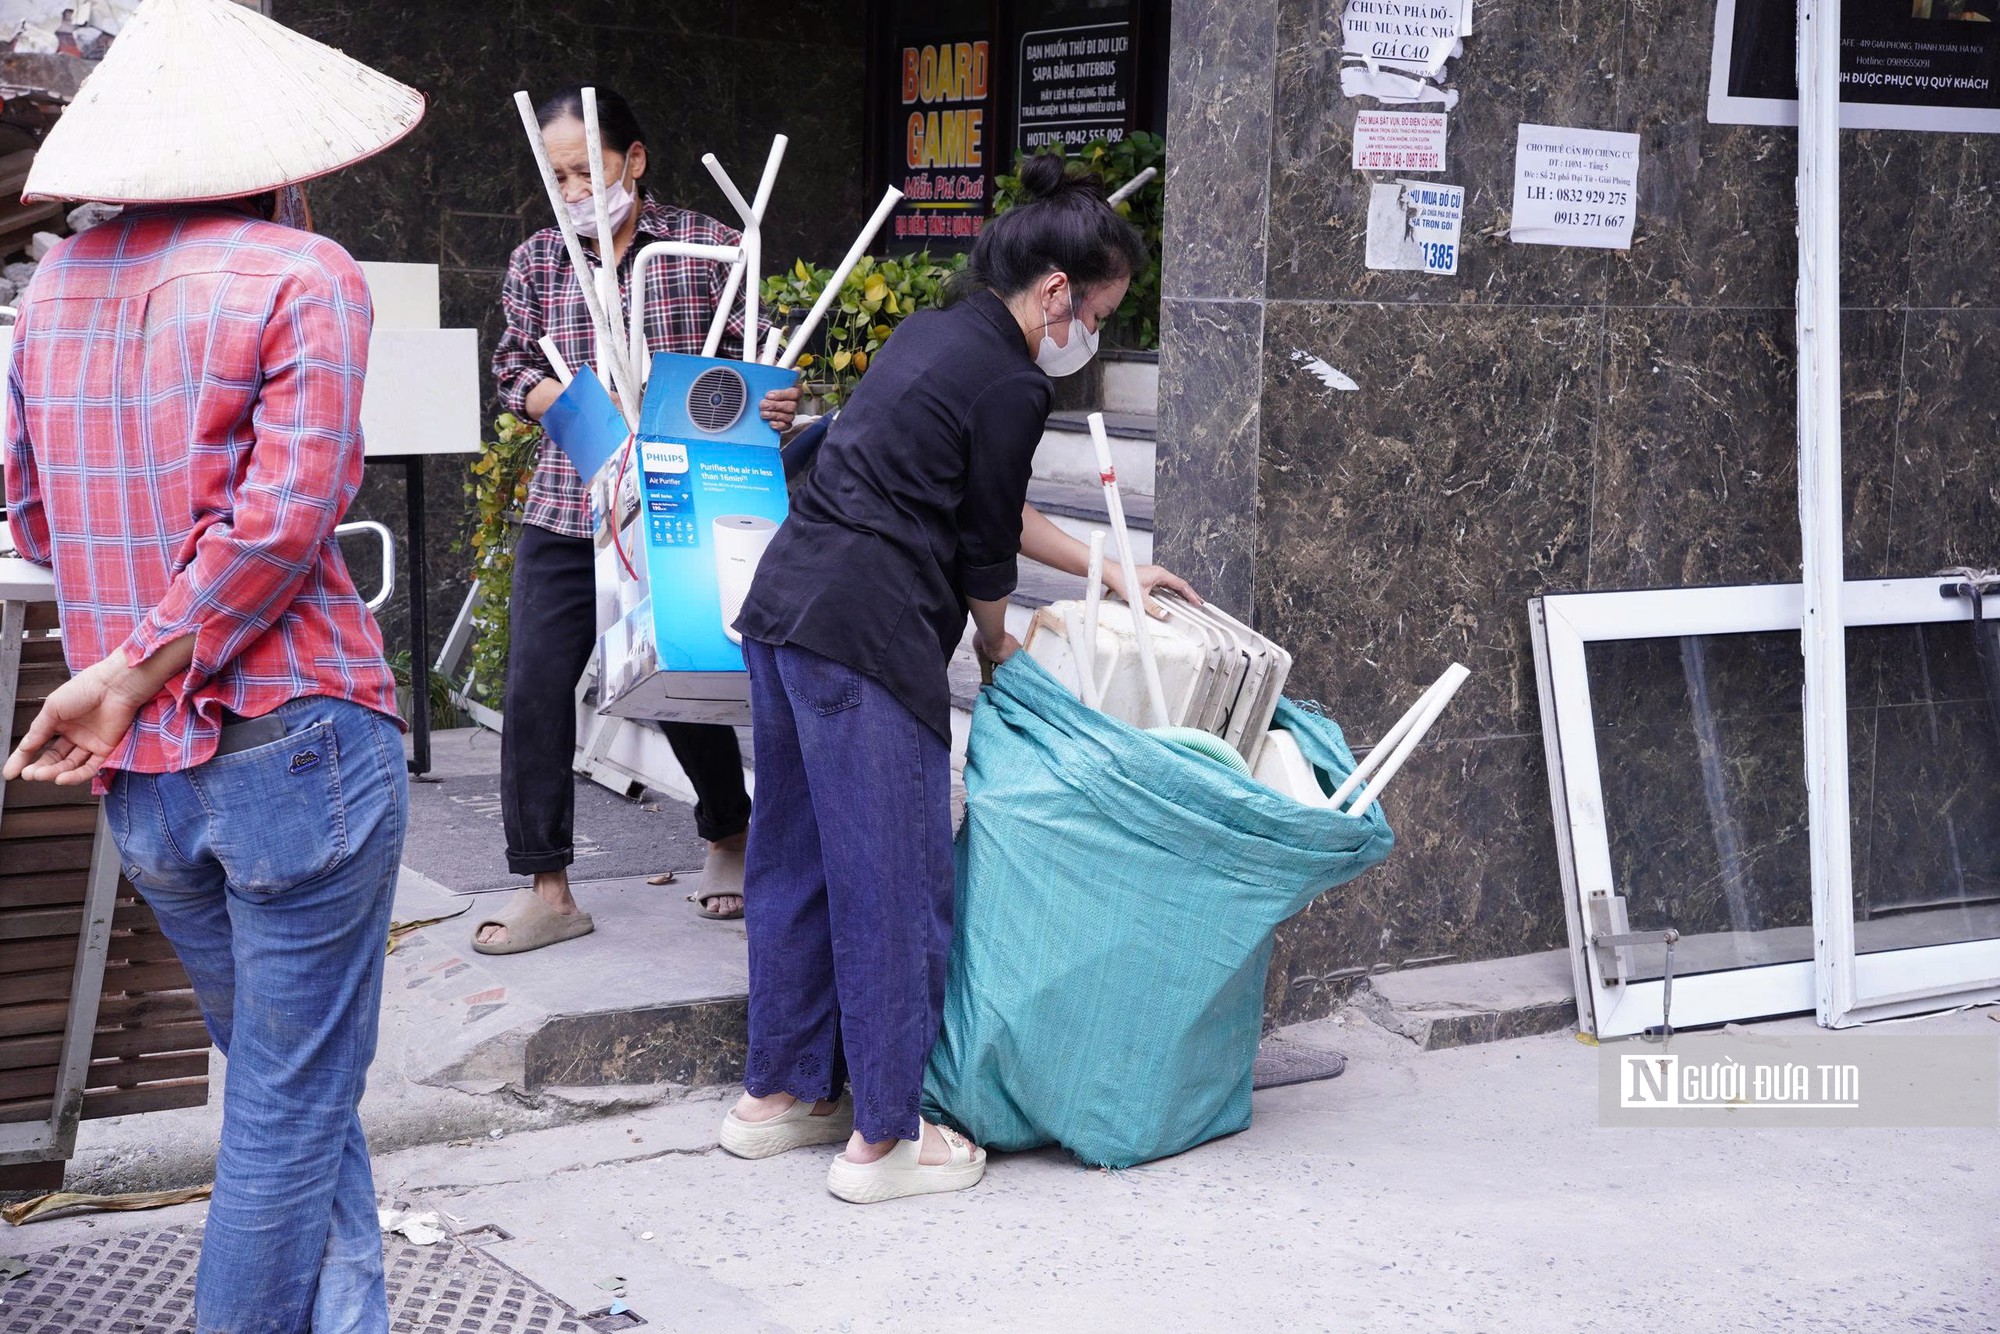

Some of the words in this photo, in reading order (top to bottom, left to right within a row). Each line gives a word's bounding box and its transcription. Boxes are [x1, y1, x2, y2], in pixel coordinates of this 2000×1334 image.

[1352, 1, 1400, 15] CHUYÊN
[1404, 4, 1427, 18] PHÁ
[1347, 20, 1371, 32] THU
[1375, 22, 1401, 35] MUA
[1404, 22, 1429, 37] XÁC
[1026, 45, 1043, 62] BẠN
[1044, 39, 1068, 58] MUỐN
[1087, 39, 1096, 54] ĐI
[1098, 39, 1110, 53] DU
[1372, 39, 1398, 57] GIÁ
[1401, 44, 1429, 59] CAO
[1915, 42, 1937, 51] THANH
[1856, 56, 1885, 66] Hotline:
[902, 41, 989, 104] BOARD
[1033, 66, 1052, 82] SAPA
[1076, 60, 1116, 78] INTERBUS
[1852, 72, 1882, 87] ĐƯỢC
[1884, 74, 1914, 89] PHỤC
[1915, 75, 1929, 90] VỤ
[1930, 74, 1953, 90] QUÝ
[1953, 75, 1989, 90] KHÁCH
[907, 109, 983, 169] GAME
[1065, 130, 1087, 145] 0942
[1106, 128, 1124, 143] 092
[1526, 143, 1543, 152] CHO
[1594, 148, 1621, 158] CHUNG
[904, 172, 933, 200] Miễn
[934, 175, 956, 200] Phí
[956, 174, 985, 200] Chơi
[1421, 190, 1437, 206] MUA
[1450, 192, 1460, 208] CŨ
[1527, 186, 1545, 200] LH
[1556, 188, 1583, 202] 0832
[1586, 190, 1605, 204] 929
[1608, 192, 1627, 206] 275
[1422, 219, 1440, 230] TRỌN
[1554, 211, 1580, 225] 0913
[1583, 213, 1601, 226] 271
[1604, 215, 1625, 228] 667
[1420, 242, 1454, 270] 1385
[646, 452, 684, 463] PHILIPS
[700, 462, 727, 472] Purifies
[728, 465, 740, 474] the
[702, 472, 718, 480] than
[660, 478, 680, 486] Purifier
